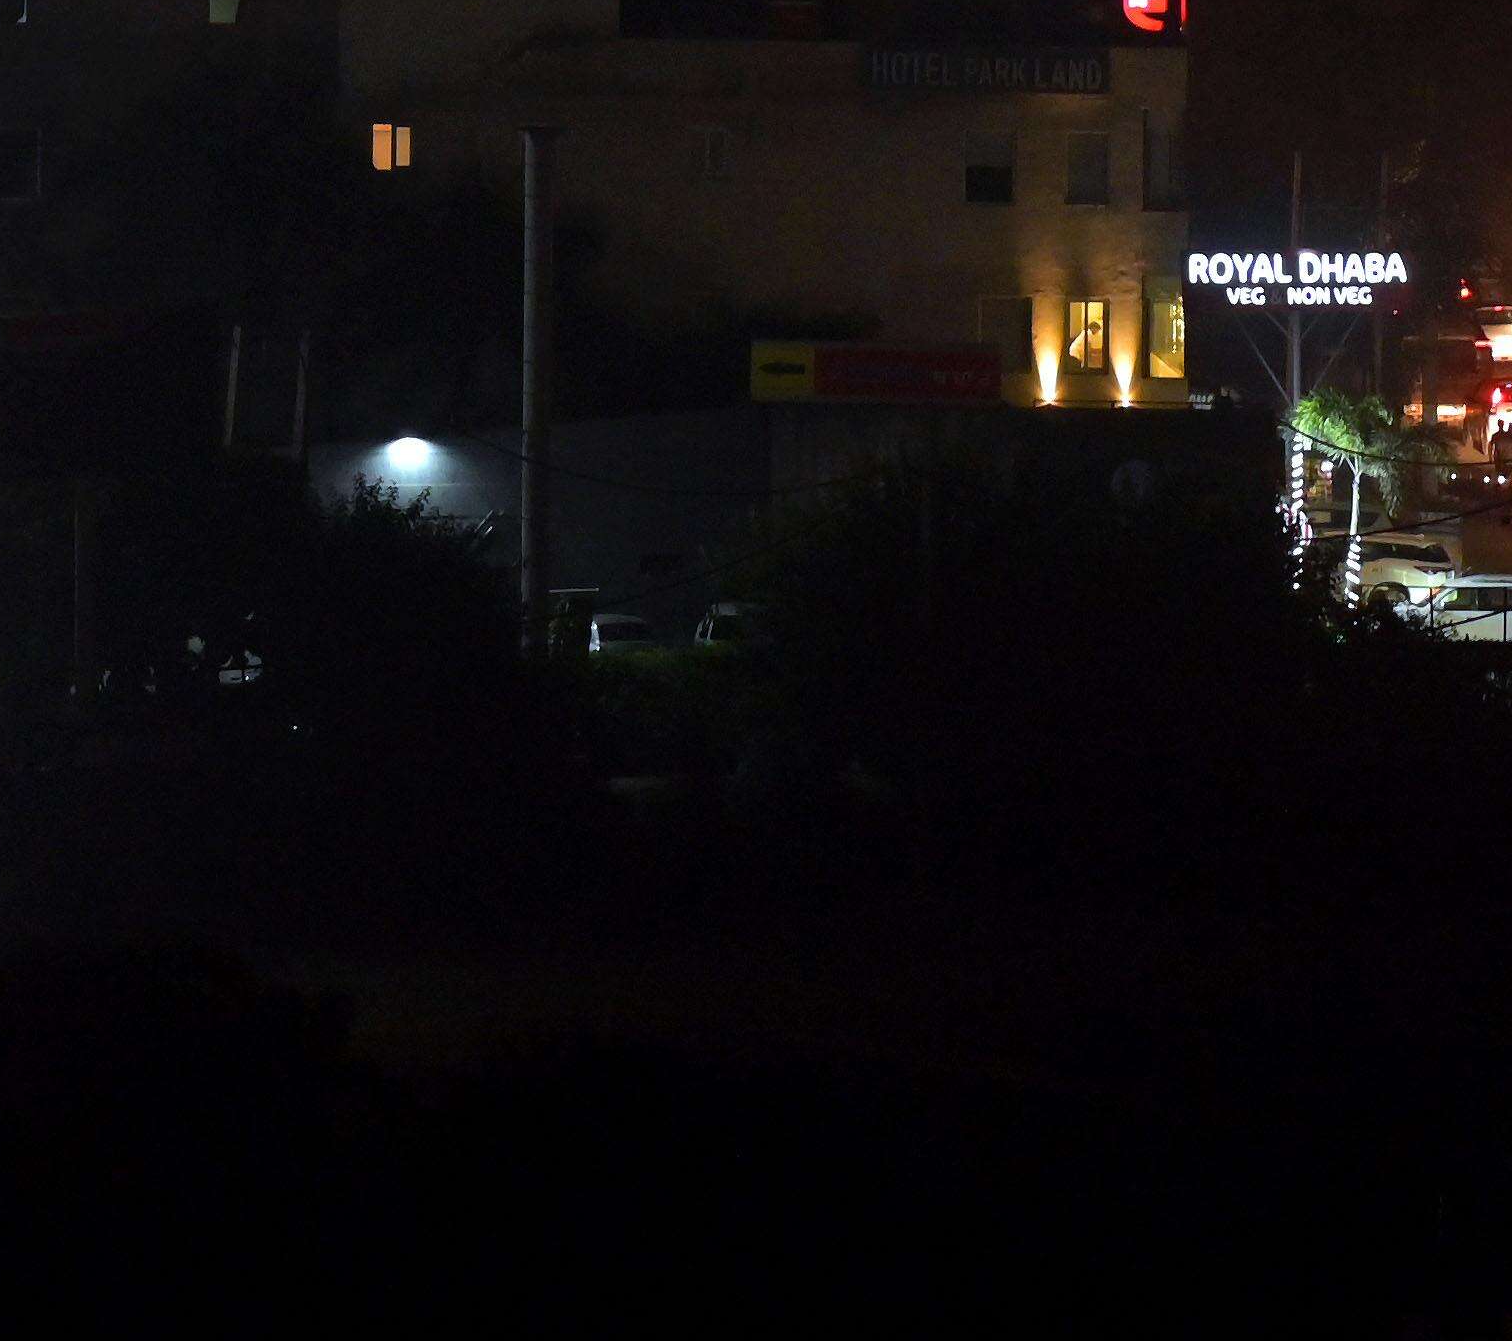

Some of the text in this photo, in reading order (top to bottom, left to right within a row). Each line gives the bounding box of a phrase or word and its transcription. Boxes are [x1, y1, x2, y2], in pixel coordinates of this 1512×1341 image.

[871, 51, 1102, 90] HOTEL PARK LAND
[1189, 252, 1408, 284] ROYAL DHABA
[1227, 286, 1266, 305] VEG
[1287, 286, 1330, 305] NON
[1333, 286, 1373, 305] VEG
